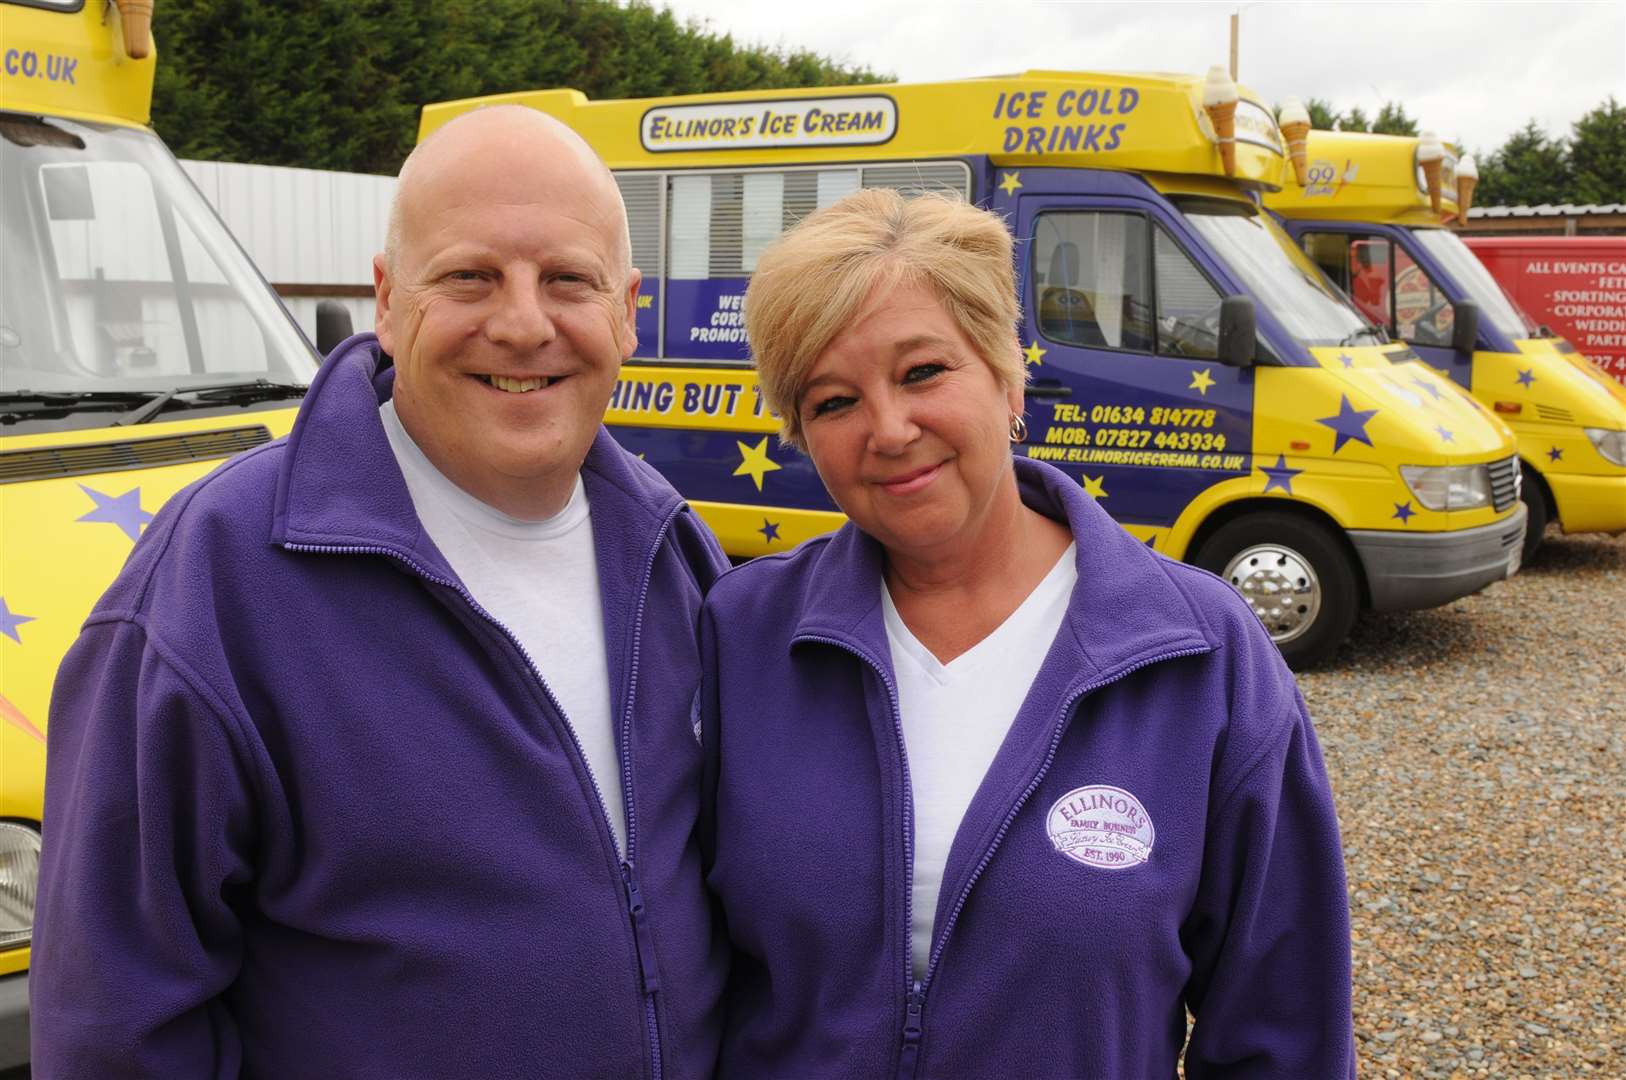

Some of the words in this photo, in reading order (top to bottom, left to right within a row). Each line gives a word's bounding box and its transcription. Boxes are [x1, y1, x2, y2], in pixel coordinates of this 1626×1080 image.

[0, 48, 78, 85] CO.UK
[993, 91, 1047, 119] ICE
[1056, 87, 1139, 117] COLD
[650, 115, 754, 139] ELLINOR'S
[759, 110, 796, 134] ICE
[803, 107, 884, 133] CREAM
[1003, 122, 1126, 155] DRINKS
[1308, 167, 1335, 184] 99
[1526, 262, 1551, 273] ALL
[1553, 261, 1605, 274] EVENTS
[690, 327, 749, 342] PROMOT
[682, 383, 743, 415] BUT
[1053, 404, 1087, 422] TEL:
[1091, 406, 1145, 425] 01634
[1149, 408, 1216, 428] 814778
[1045, 427, 1091, 445] MOB:
[1095, 429, 1151, 448] 07827
[1153, 431, 1226, 451] 443934
[1028, 446, 1245, 470] WWW.ELLINORSICECREAM.CO.UK
[1060, 794, 1146, 829] ELLINORS
